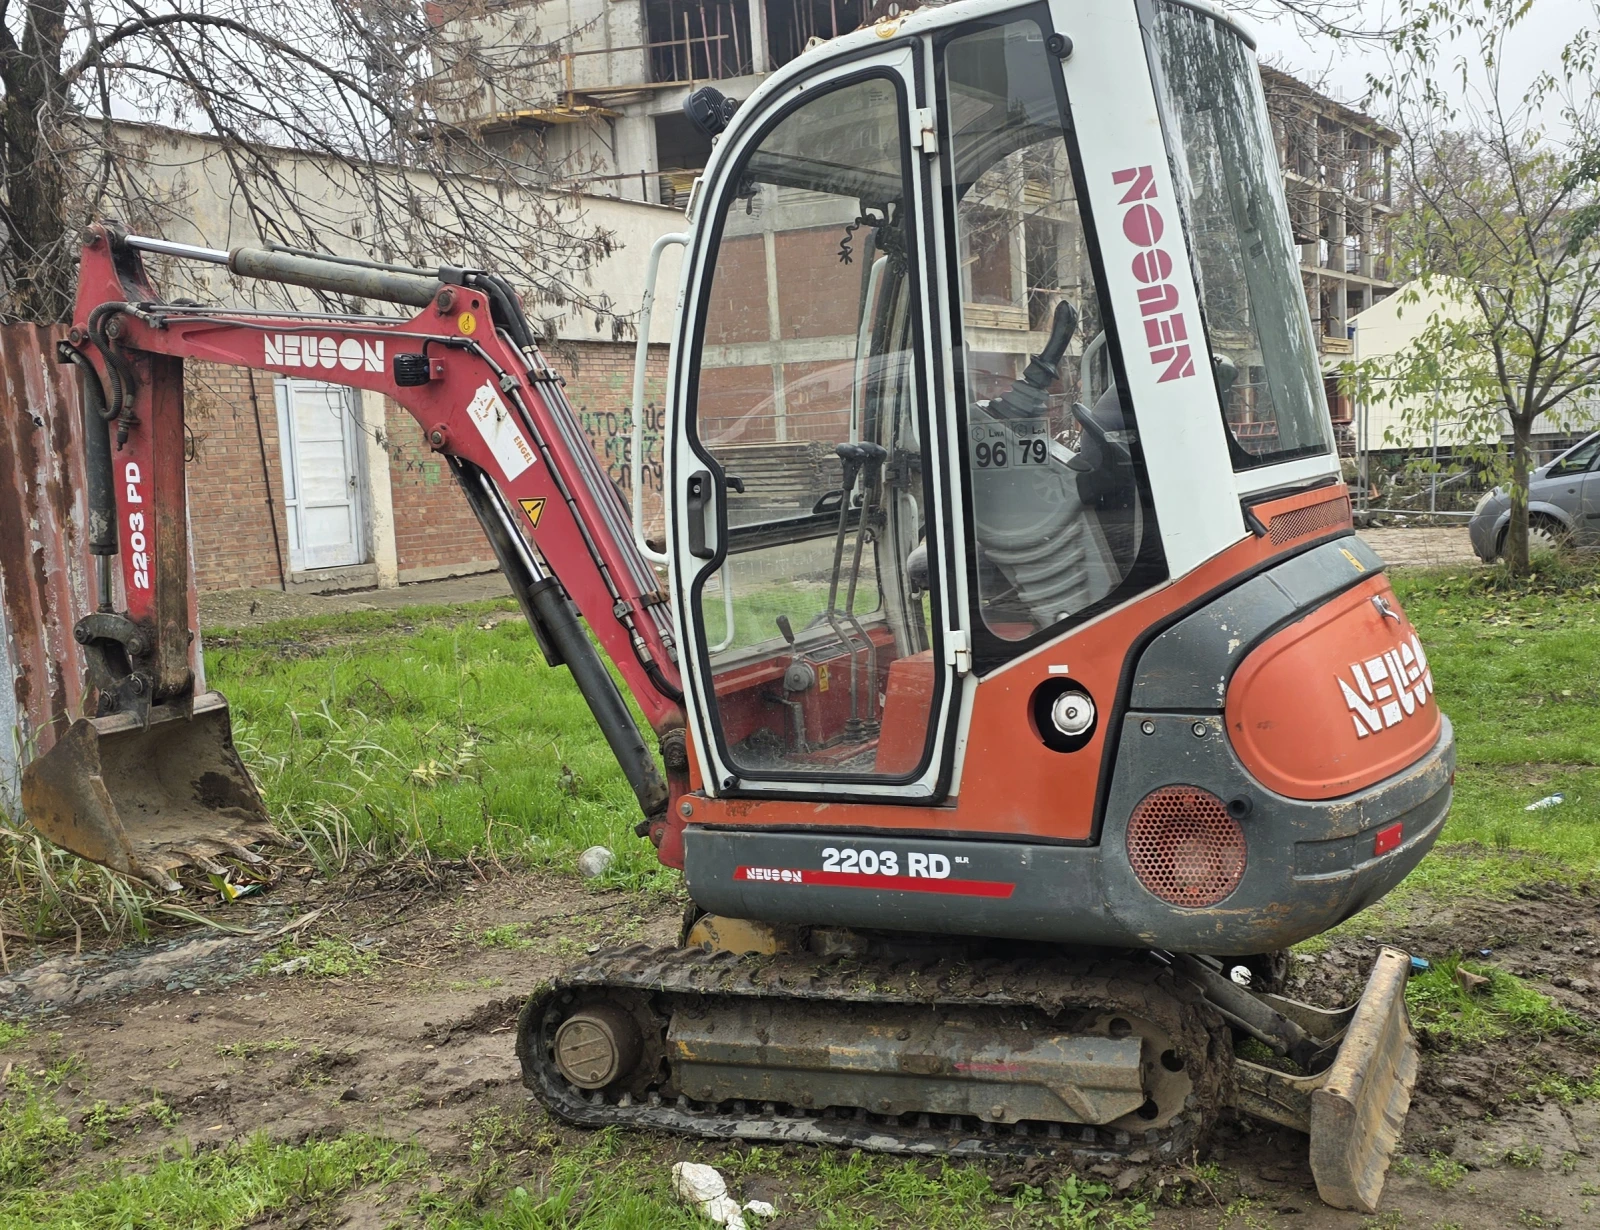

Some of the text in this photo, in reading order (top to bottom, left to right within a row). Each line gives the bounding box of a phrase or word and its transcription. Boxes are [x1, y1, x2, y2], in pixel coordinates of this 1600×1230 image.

[1111, 165, 1196, 384] NEUSON
[264, 333, 385, 373] NEUSON
[513, 435, 533, 464] ENGEL
[975, 441, 1007, 468] 96
[1018, 439, 1047, 464] 79
[125, 462, 149, 589] 2203 PD
[746, 868, 803, 883] NEUSON
[822, 847, 900, 876] 2203
[907, 852, 951, 880] RD
